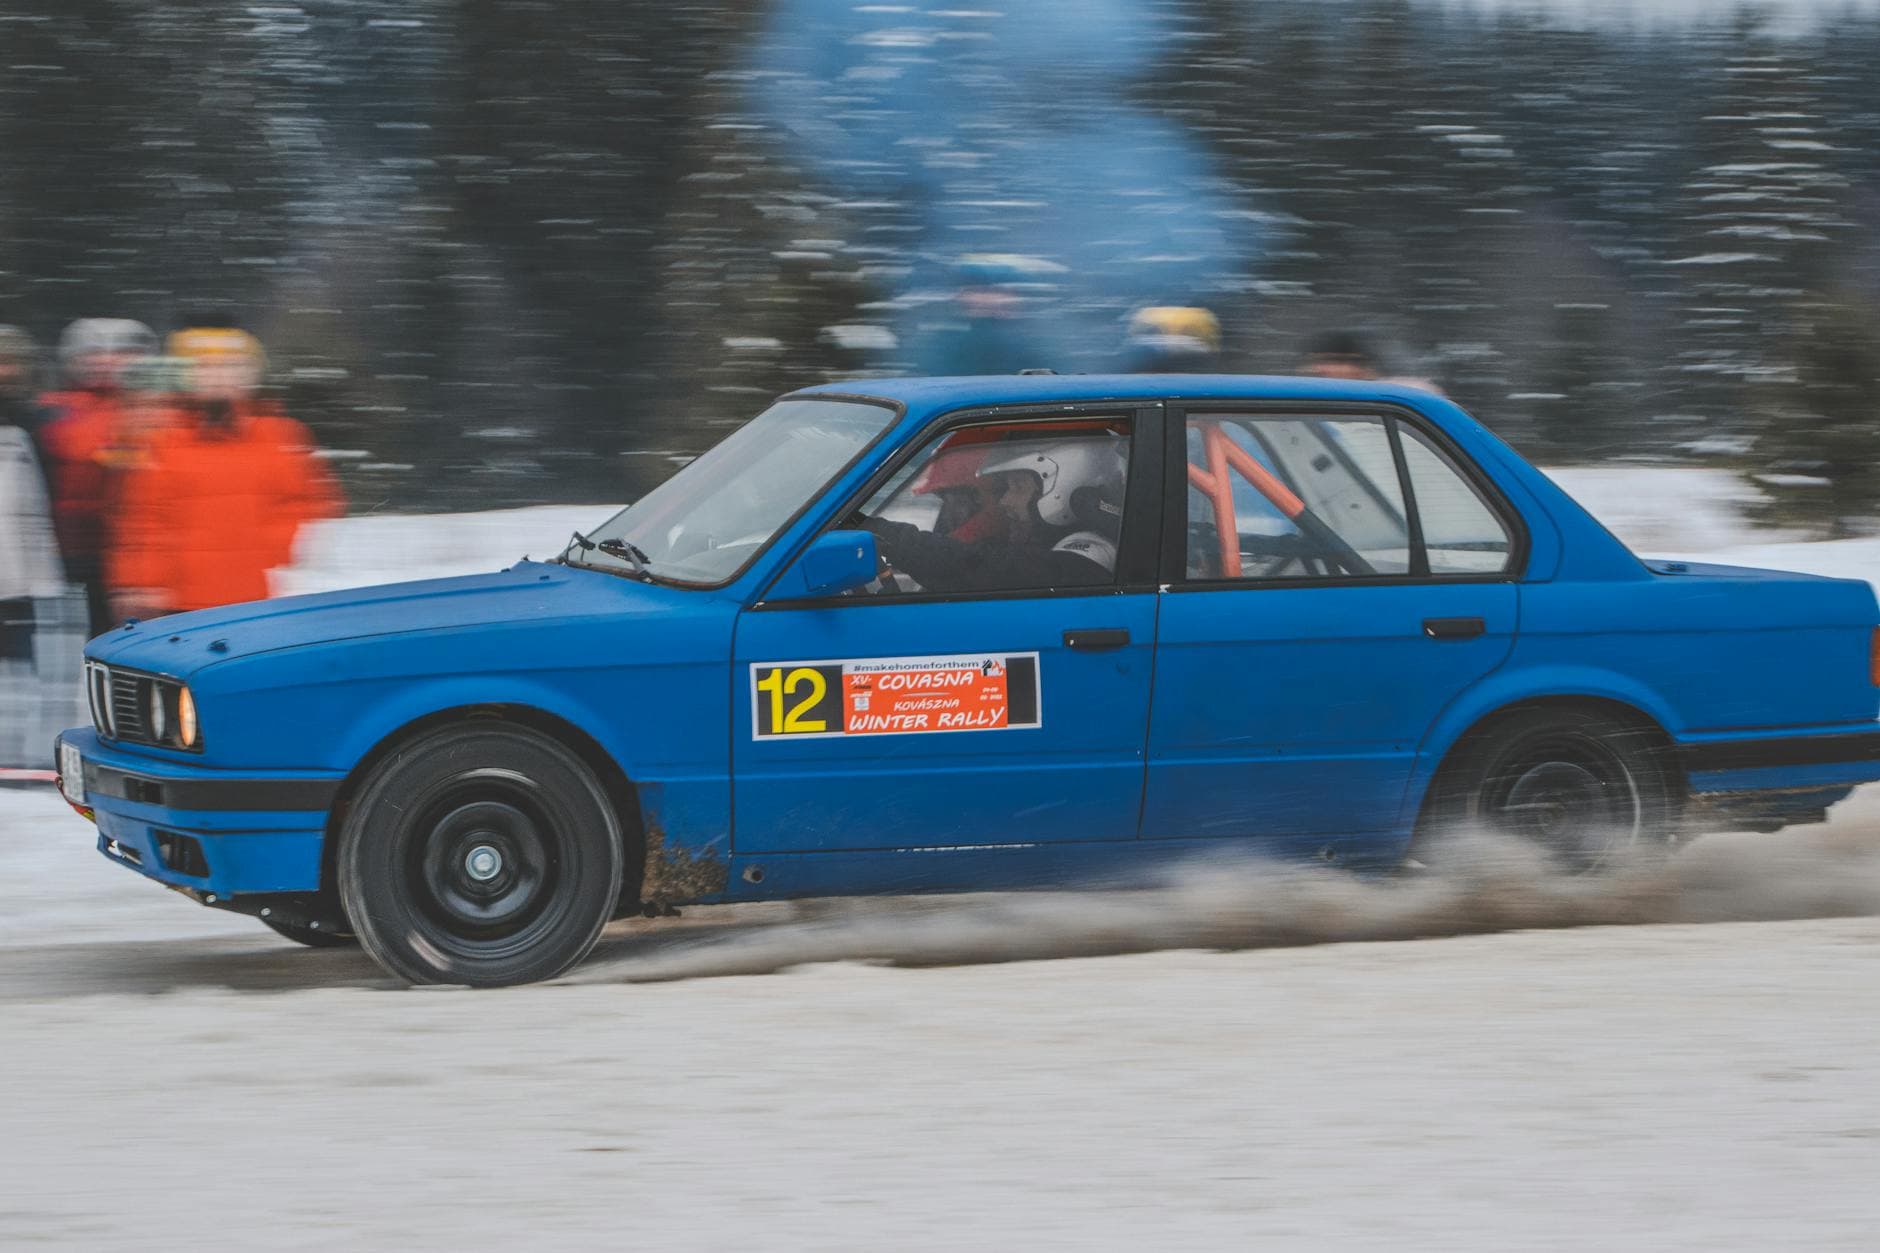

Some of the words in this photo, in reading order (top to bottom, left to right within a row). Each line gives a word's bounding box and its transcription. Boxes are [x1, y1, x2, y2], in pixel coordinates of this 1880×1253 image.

[854, 661, 979, 671] #makehomeforthem
[878, 671, 974, 690] COVASNA
[757, 668, 826, 733] 12
[894, 698, 960, 712] KOVÁSZNA
[850, 714, 928, 731] WINTER
[938, 706, 1005, 727] RALLY
